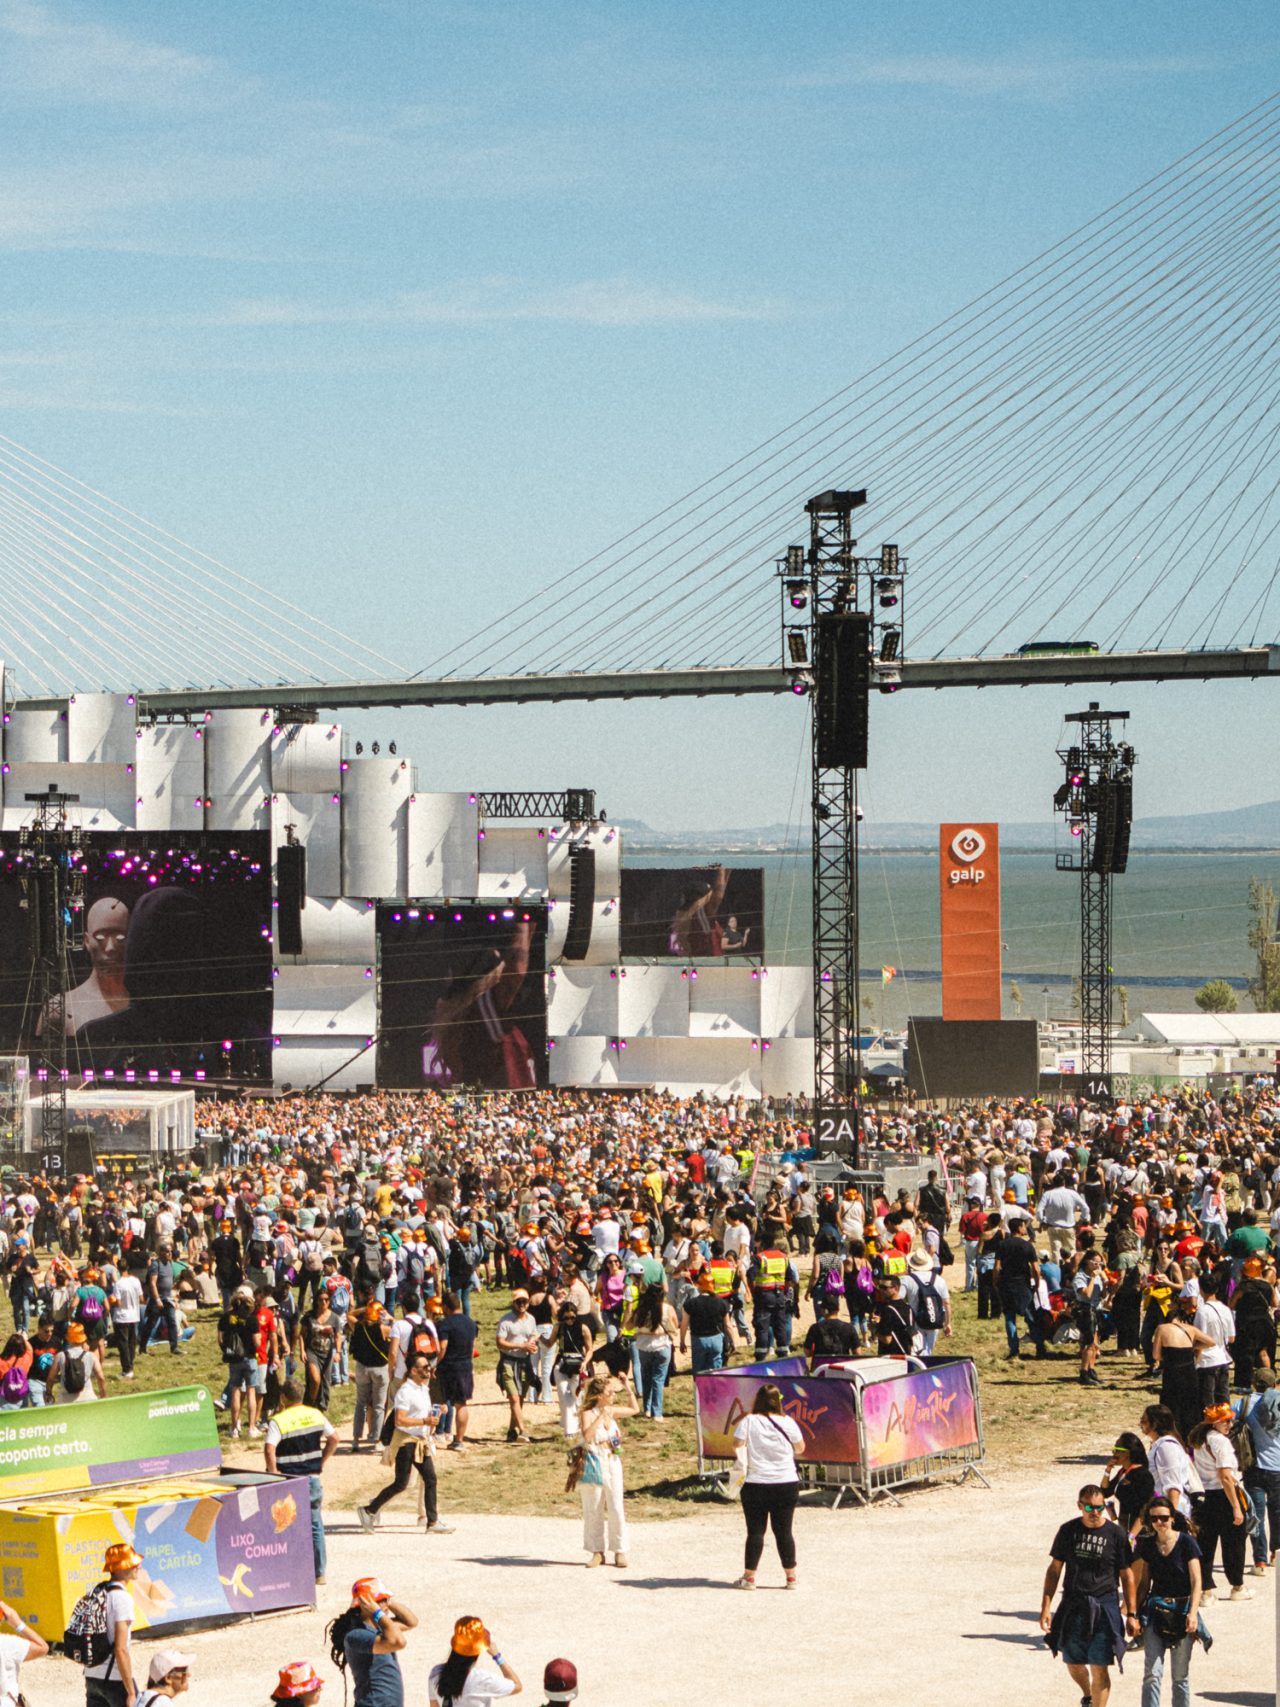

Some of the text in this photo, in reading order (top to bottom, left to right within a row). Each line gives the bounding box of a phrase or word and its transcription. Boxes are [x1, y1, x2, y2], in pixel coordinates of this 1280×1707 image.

[950, 867, 985, 884] galp
[1088, 1081, 1109, 1095] 1A
[819, 1119, 854, 1141] 2A
[42, 1154, 62, 1169] 1B
[148, 1401, 200, 1419] pontoverde
[927, 1391, 958, 1428] Rio
[19, 1422, 68, 1439] sempre
[53, 1439, 93, 1456] certo.
[231, 1533, 255, 1547] LIXO
[80, 1552, 106, 1566] META
[145, 1544, 176, 1558] PAPEL
[245, 1543, 288, 1559] COMUM
[159, 1551, 203, 1571] CARTÃO
